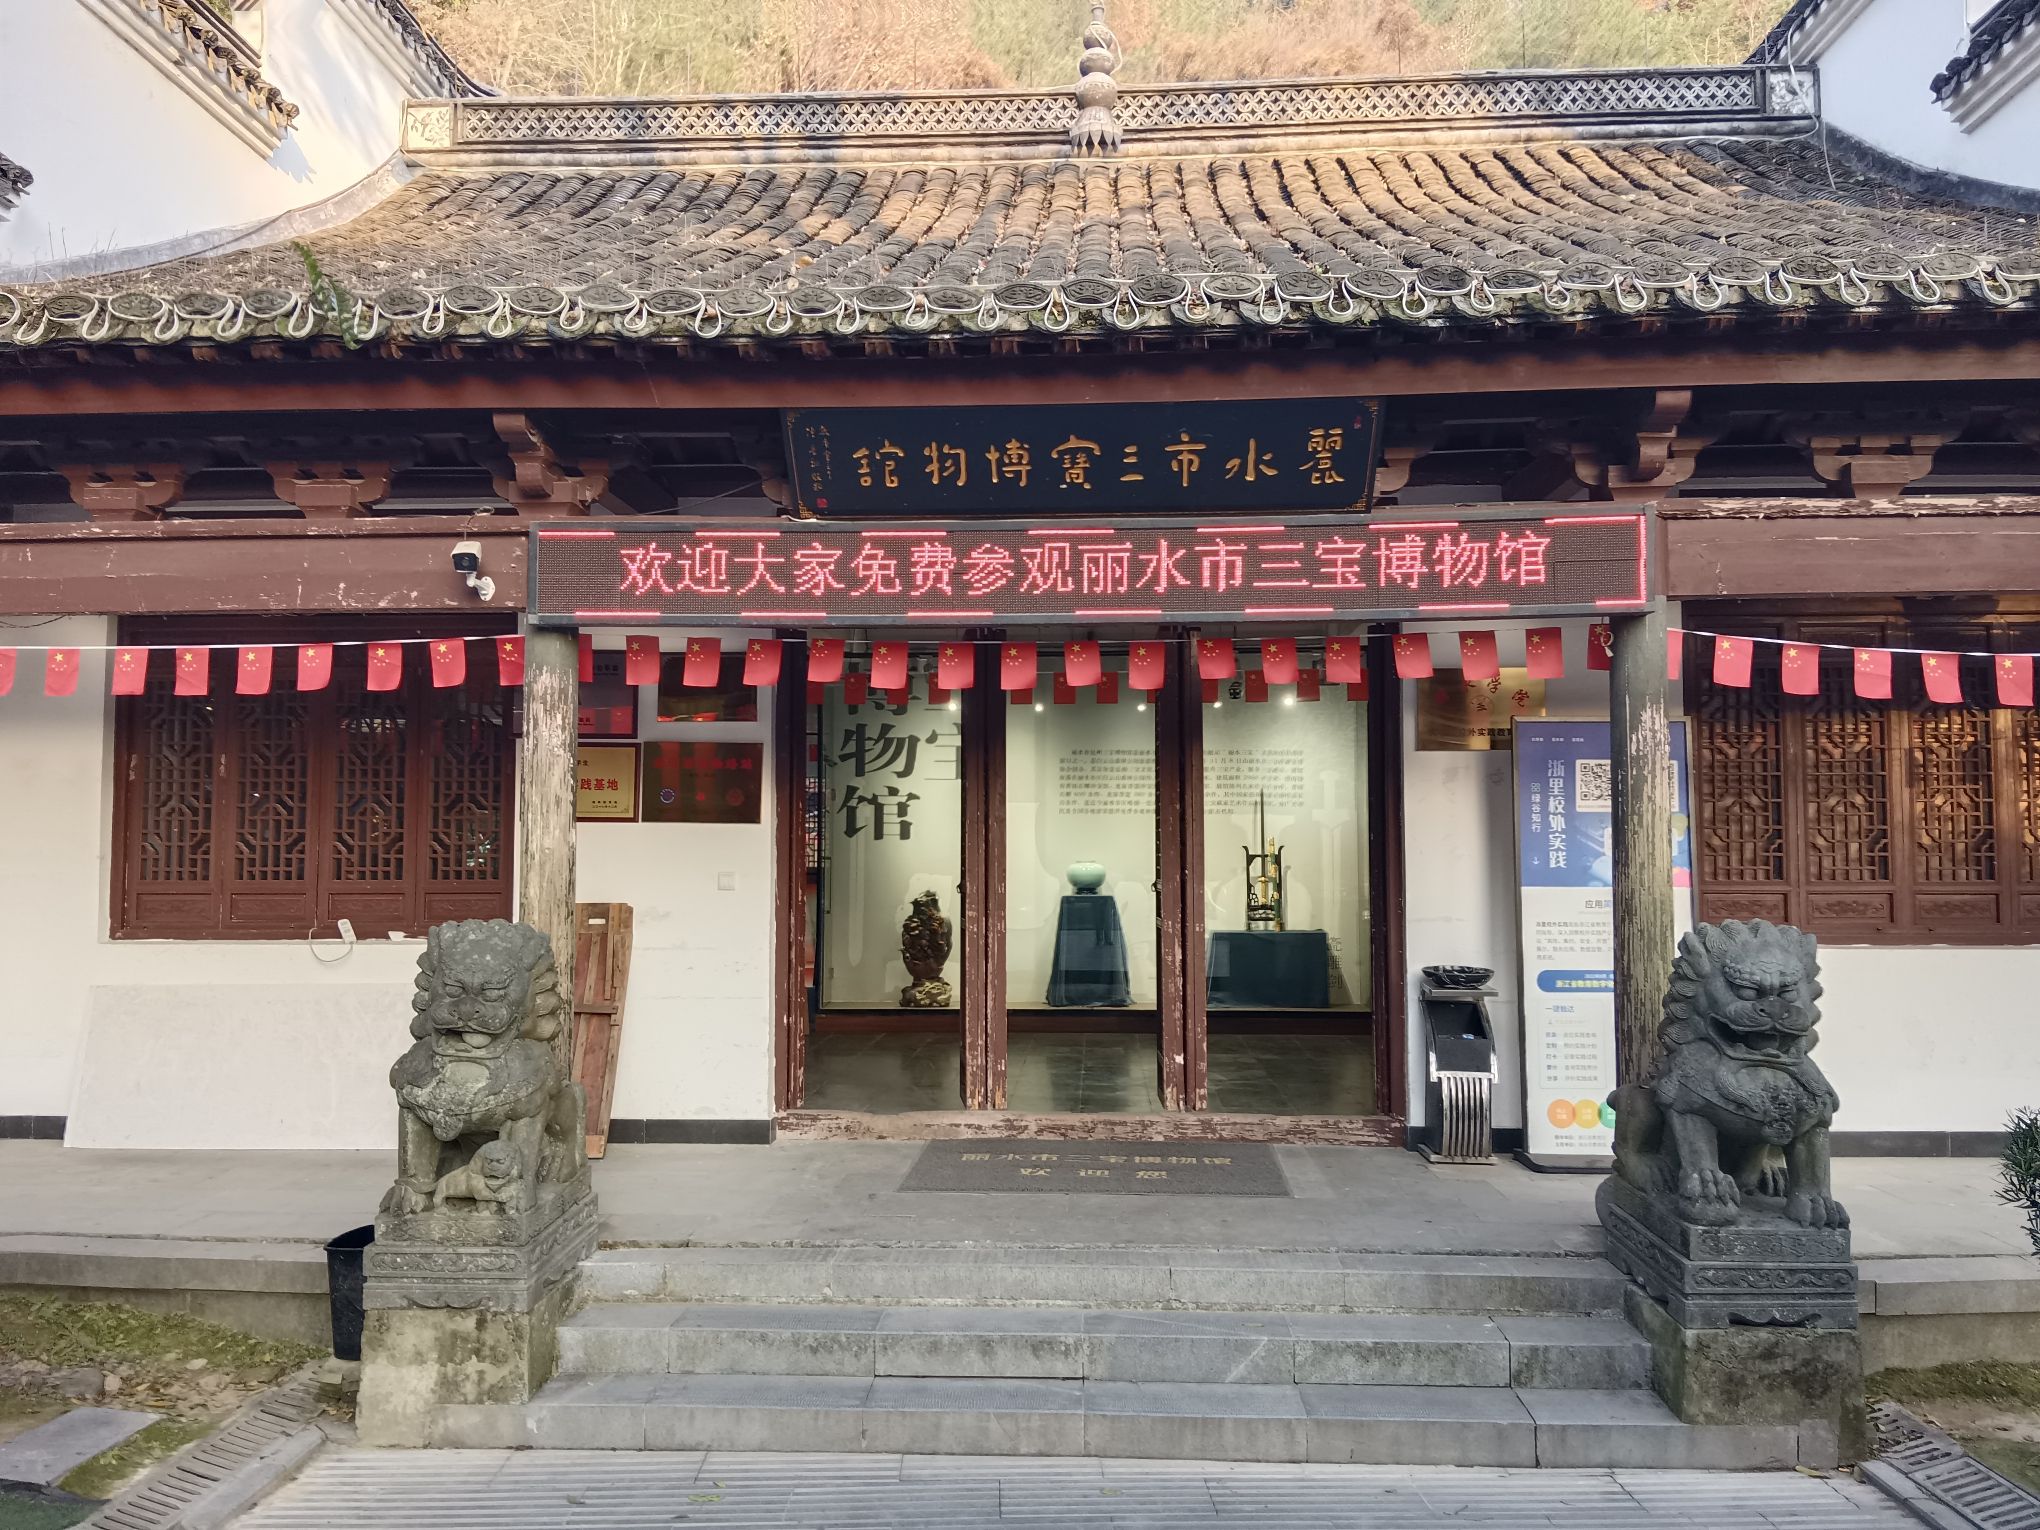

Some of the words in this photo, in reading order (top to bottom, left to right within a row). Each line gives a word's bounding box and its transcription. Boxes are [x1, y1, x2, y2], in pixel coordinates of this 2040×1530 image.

[619, 531, 1552, 596] 欢迎大家免费参观丽水市三宝博物馆
[576, 778, 619, 791] 践基地
[1547, 760, 1567, 868] 浙里校外实践
[960, 1153, 1231, 1164] 丽水市三宝博物馆
